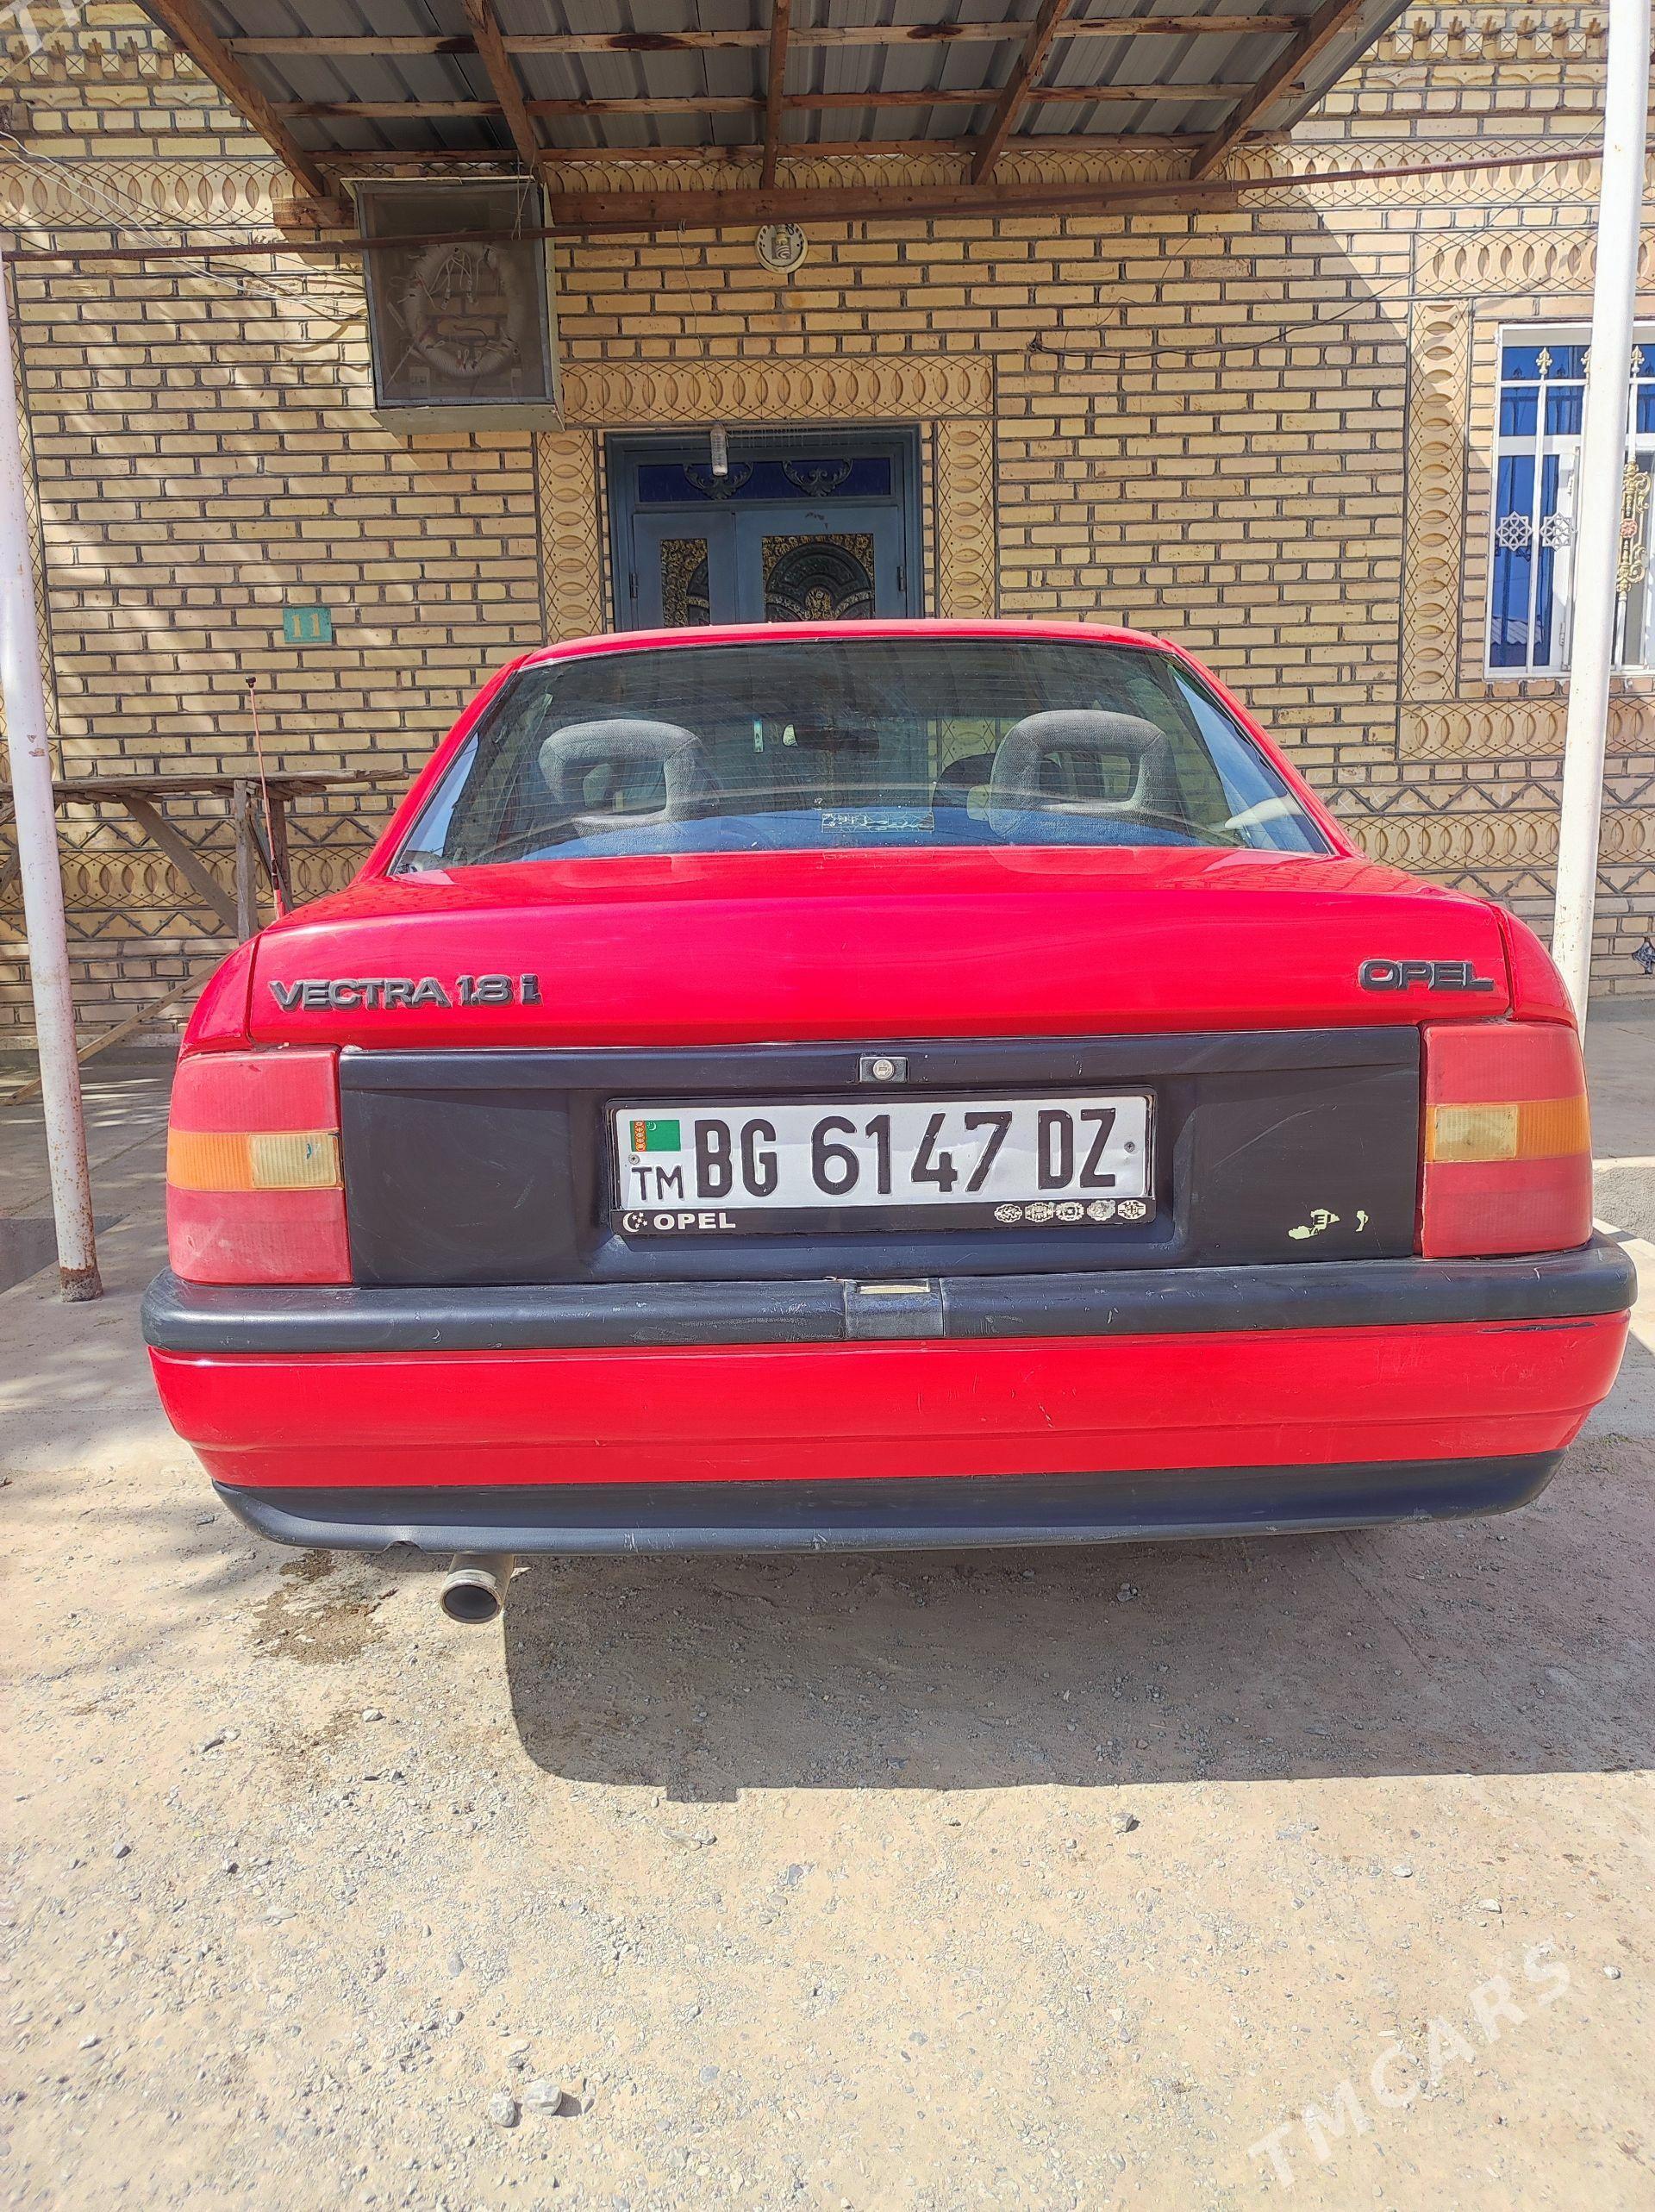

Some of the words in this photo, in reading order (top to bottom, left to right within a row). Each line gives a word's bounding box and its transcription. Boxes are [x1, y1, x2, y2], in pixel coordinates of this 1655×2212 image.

[292, 613, 321, 638] 11
[1359, 959, 1494, 991] OPEL
[268, 978, 453, 1012] VECTRA
[695, 1118, 778, 1198] BG
[810, 1110, 1014, 1196] 6147
[1036, 1108, 1117, 1190] DZ
[631, 1165, 684, 1201] TM
[653, 1212, 736, 1231] OPEL
